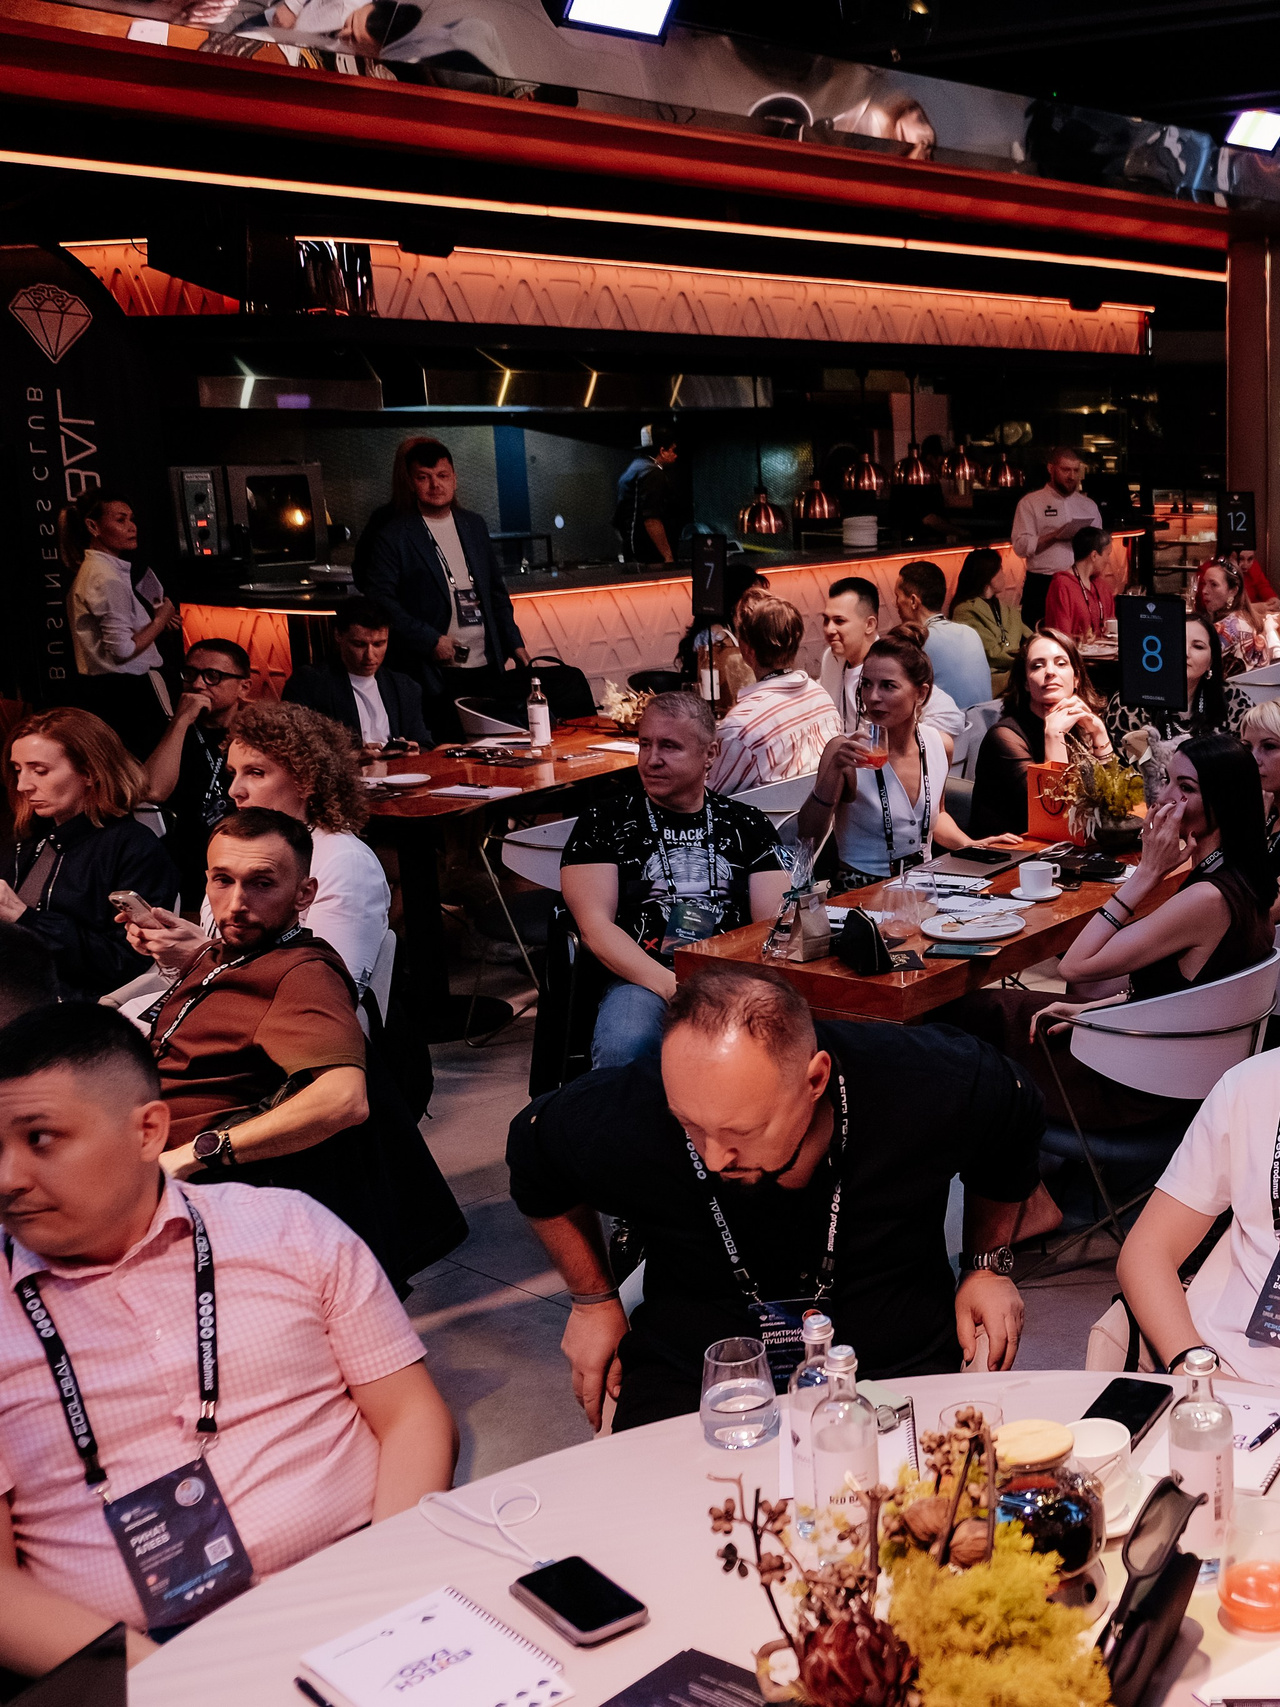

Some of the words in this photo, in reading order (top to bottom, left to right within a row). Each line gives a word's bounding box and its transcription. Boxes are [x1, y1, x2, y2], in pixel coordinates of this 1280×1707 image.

[1227, 512, 1247, 531] 12
[703, 562, 715, 590] 7
[1142, 635, 1163, 672] 8
[879, 785, 892, 829] EDGLOBAL
[663, 828, 705, 842] BLACK
[709, 1197, 737, 1255] EDGLOBAL
[827, 1213, 838, 1252] prodamus
[762, 1327, 803, 1339] ДМИТРИЙ
[200, 1342, 214, 1391] prodamus
[55, 1353, 88, 1437] EDGLOBAL
[130, 1521, 167, 1549] РИНАТ
[135, 1532, 171, 1558] АЛЕЕВ
